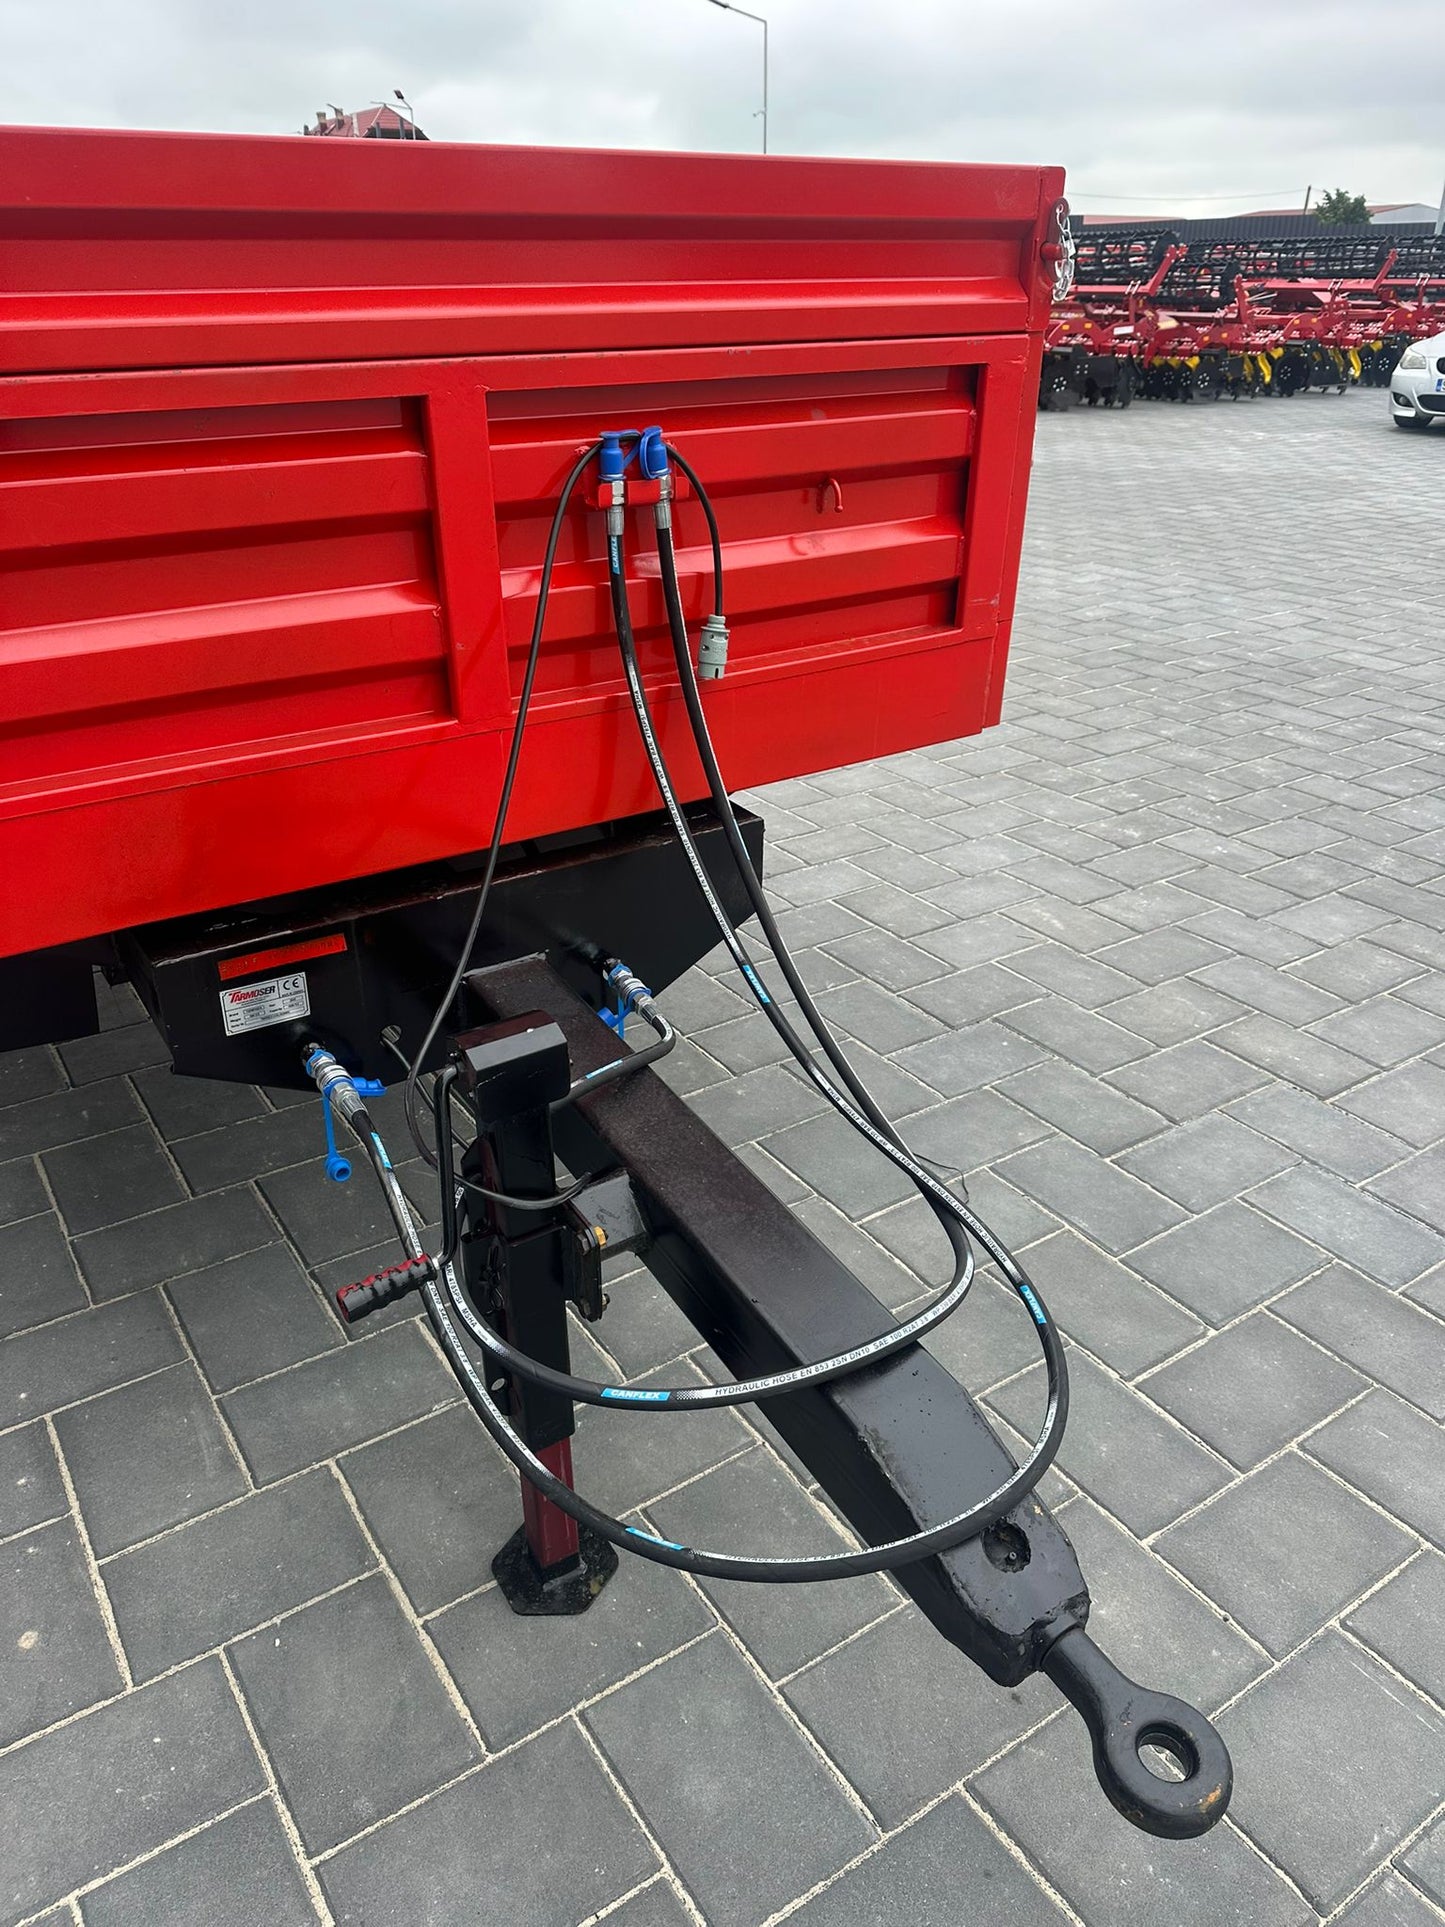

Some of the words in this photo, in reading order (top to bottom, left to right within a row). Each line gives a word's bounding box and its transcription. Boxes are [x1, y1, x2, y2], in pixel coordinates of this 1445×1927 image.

[704, 888, 715, 905] HOSE
[228, 986, 276, 1003] TARMOSER
[283, 978, 300, 990] CE
[961, 1210, 971, 1220] EN
[969, 1218, 984, 1233] HOSE
[981, 1231, 1007, 1262] HYDRAULIC
[409, 1230, 420, 1248] HOSE
[438, 1306, 448, 1321] SAE
[445, 1322, 454, 1334] 100
[448, 1276, 462, 1304] 4785PSI
[460, 1307, 478, 1328] MSHA
[1023, 1288, 1042, 1319] CANFLEX
[610, 1389, 660, 1398] CANFLEX
[714, 1378, 769, 1395] HYDRAULIC
[771, 1371, 797, 1384] HOSE
[799, 1367, 812, 1376] EN
[814, 1361, 829, 1372] 853
[830, 1355, 847, 1366] 2SN
[848, 1346, 870, 1360] DN10
[872, 1338, 889, 1349] SAE
[889, 1330, 902, 1341] 100
[902, 1321, 920, 1334] R2AT
